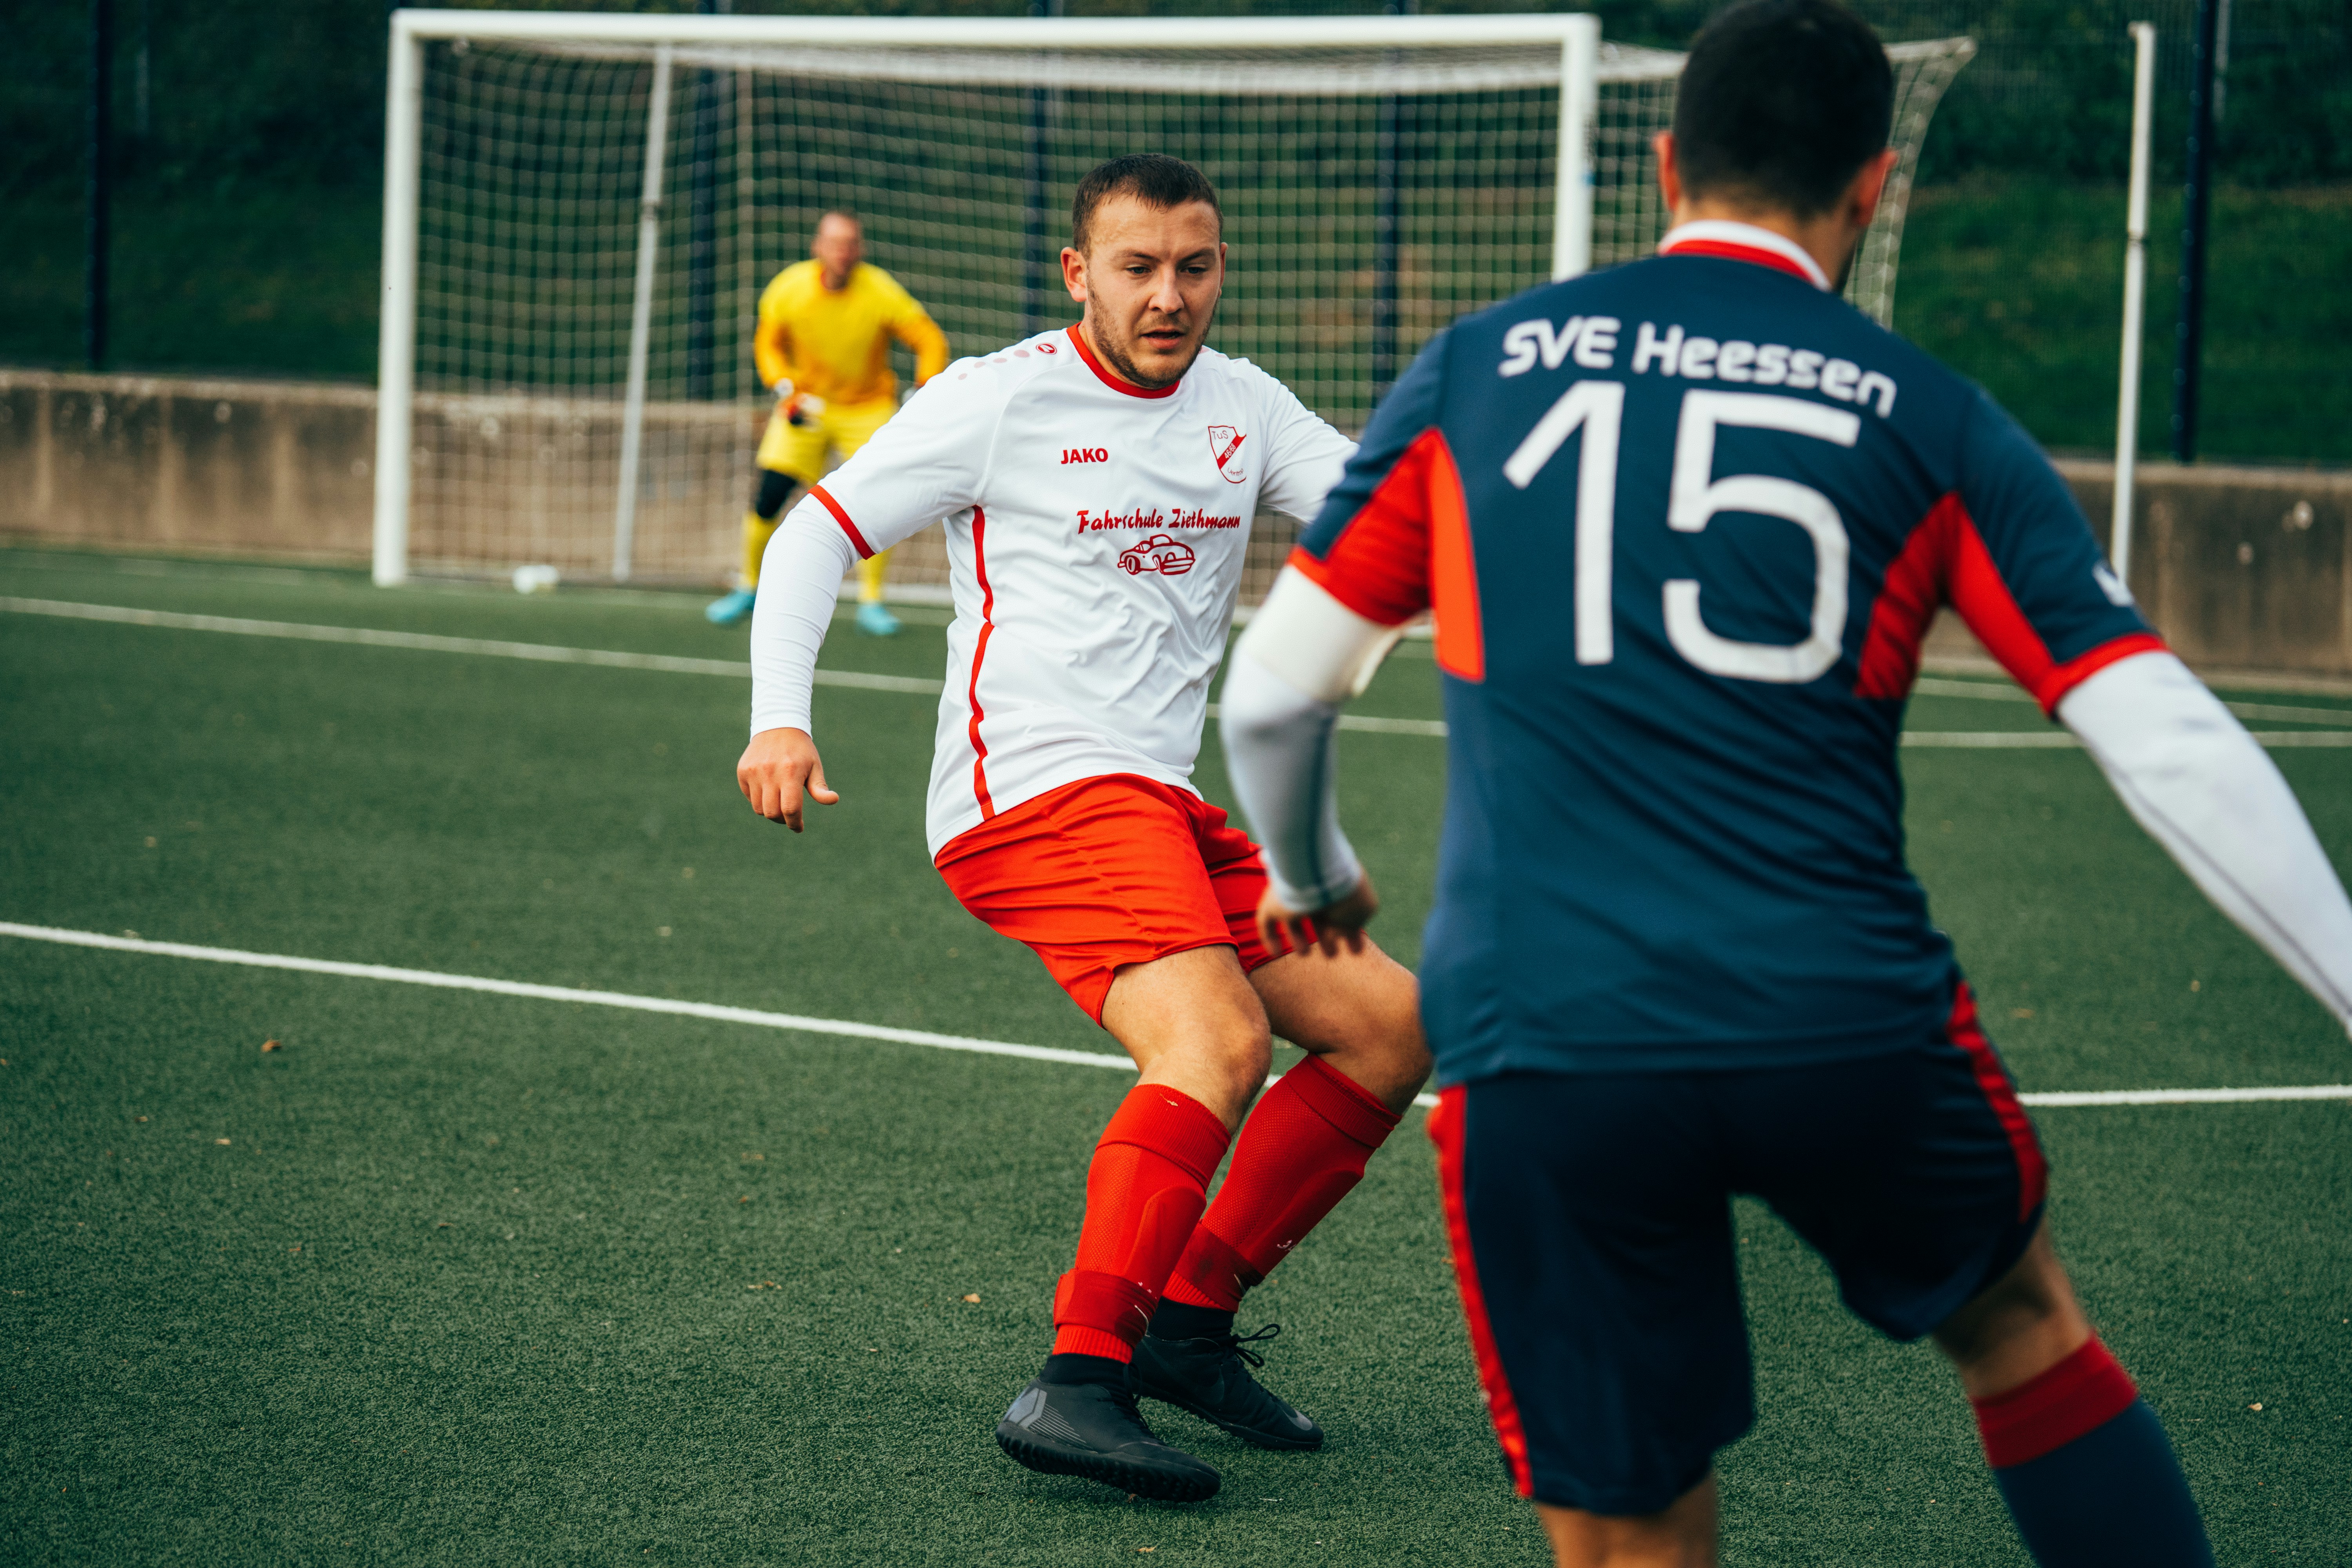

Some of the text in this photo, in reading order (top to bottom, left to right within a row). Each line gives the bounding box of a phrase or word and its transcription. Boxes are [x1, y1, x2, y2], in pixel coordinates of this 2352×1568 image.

[1498, 315, 1897, 418] SVE Heessen
[1212, 430, 1229, 440] TuS
[1061, 448, 1109, 465] JAKO
[1224, 443, 1236, 459] 46/68
[1076, 508, 1241, 535] Fahrschule Ziethmann
[1503, 379, 1861, 684] 15
